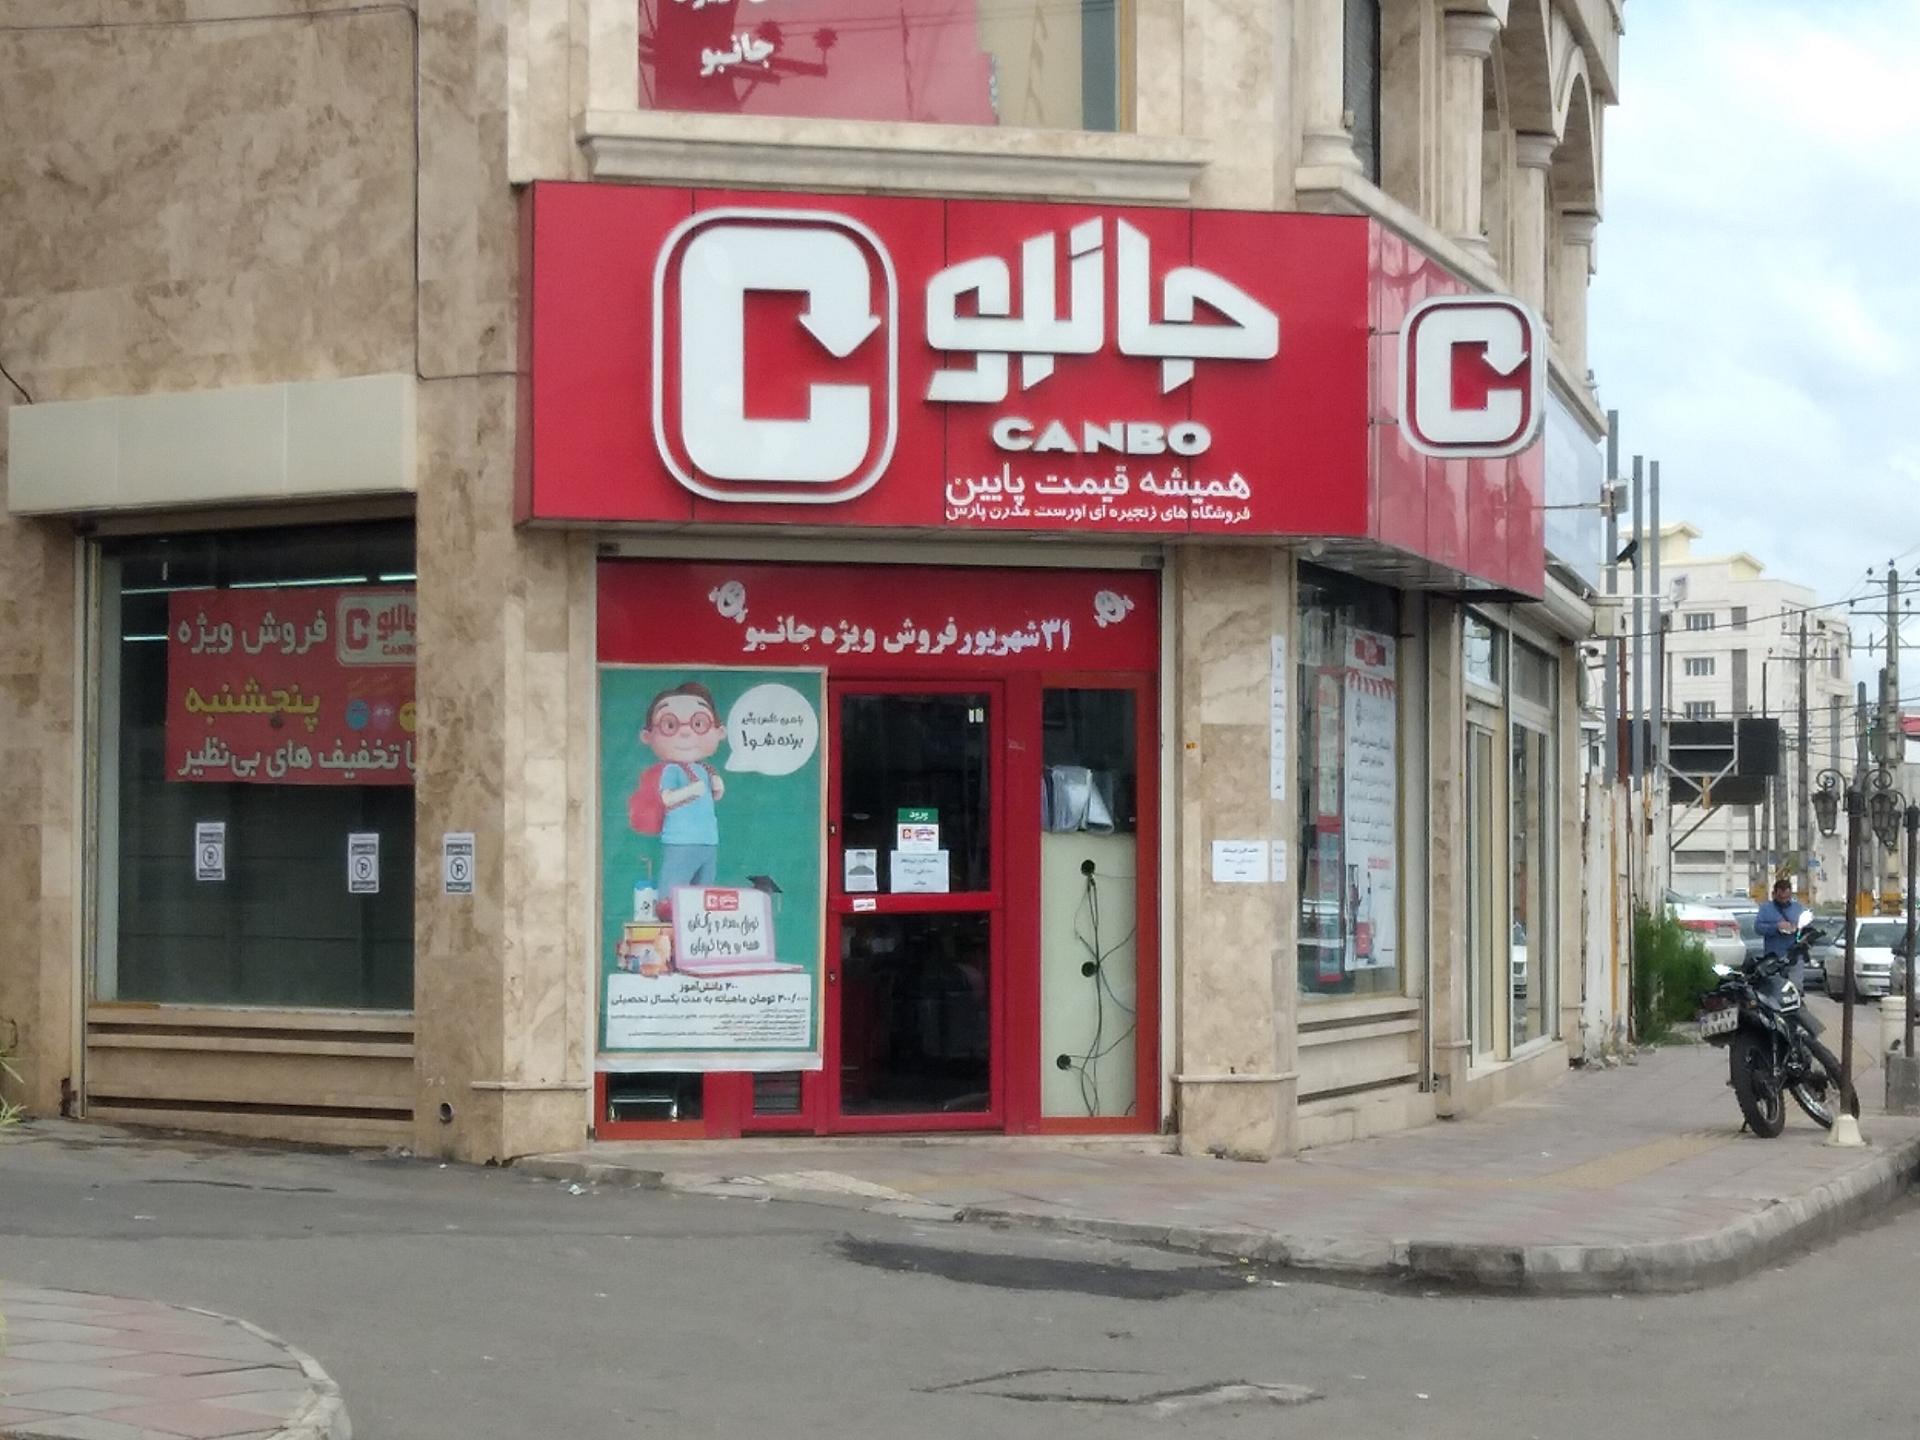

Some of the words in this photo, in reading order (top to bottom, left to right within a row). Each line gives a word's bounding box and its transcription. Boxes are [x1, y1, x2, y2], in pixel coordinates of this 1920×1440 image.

[701, 32, 775, 77] جانبو
[926, 215, 1280, 402] جانبو
[991, 416, 1212, 456] CANBO
[944, 461, 1025, 505] پایین
[1035, 465, 1129, 504] قیمت
[1139, 466, 1251, 504] همیشه
[945, 506, 986, 523] پارس
[1110, 505, 1157, 522] زنجیره
[1161, 505, 1188, 521] های
[1191, 505, 1251, 524] فروشگاه
[178, 611, 233, 655] ویژه
[242, 609, 328, 654] فروش
[742, 615, 817, 652] جانبو
[820, 619, 876, 654] ویژه
[884, 616, 958, 654] فروش
[957, 620, 1041, 656] شهریور
[1041, 618, 1071, 652] ۳۱
[185, 677, 320, 732] پنجشنبه
[266, 740, 313, 777] های
[318, 739, 400, 779] تخفیف
